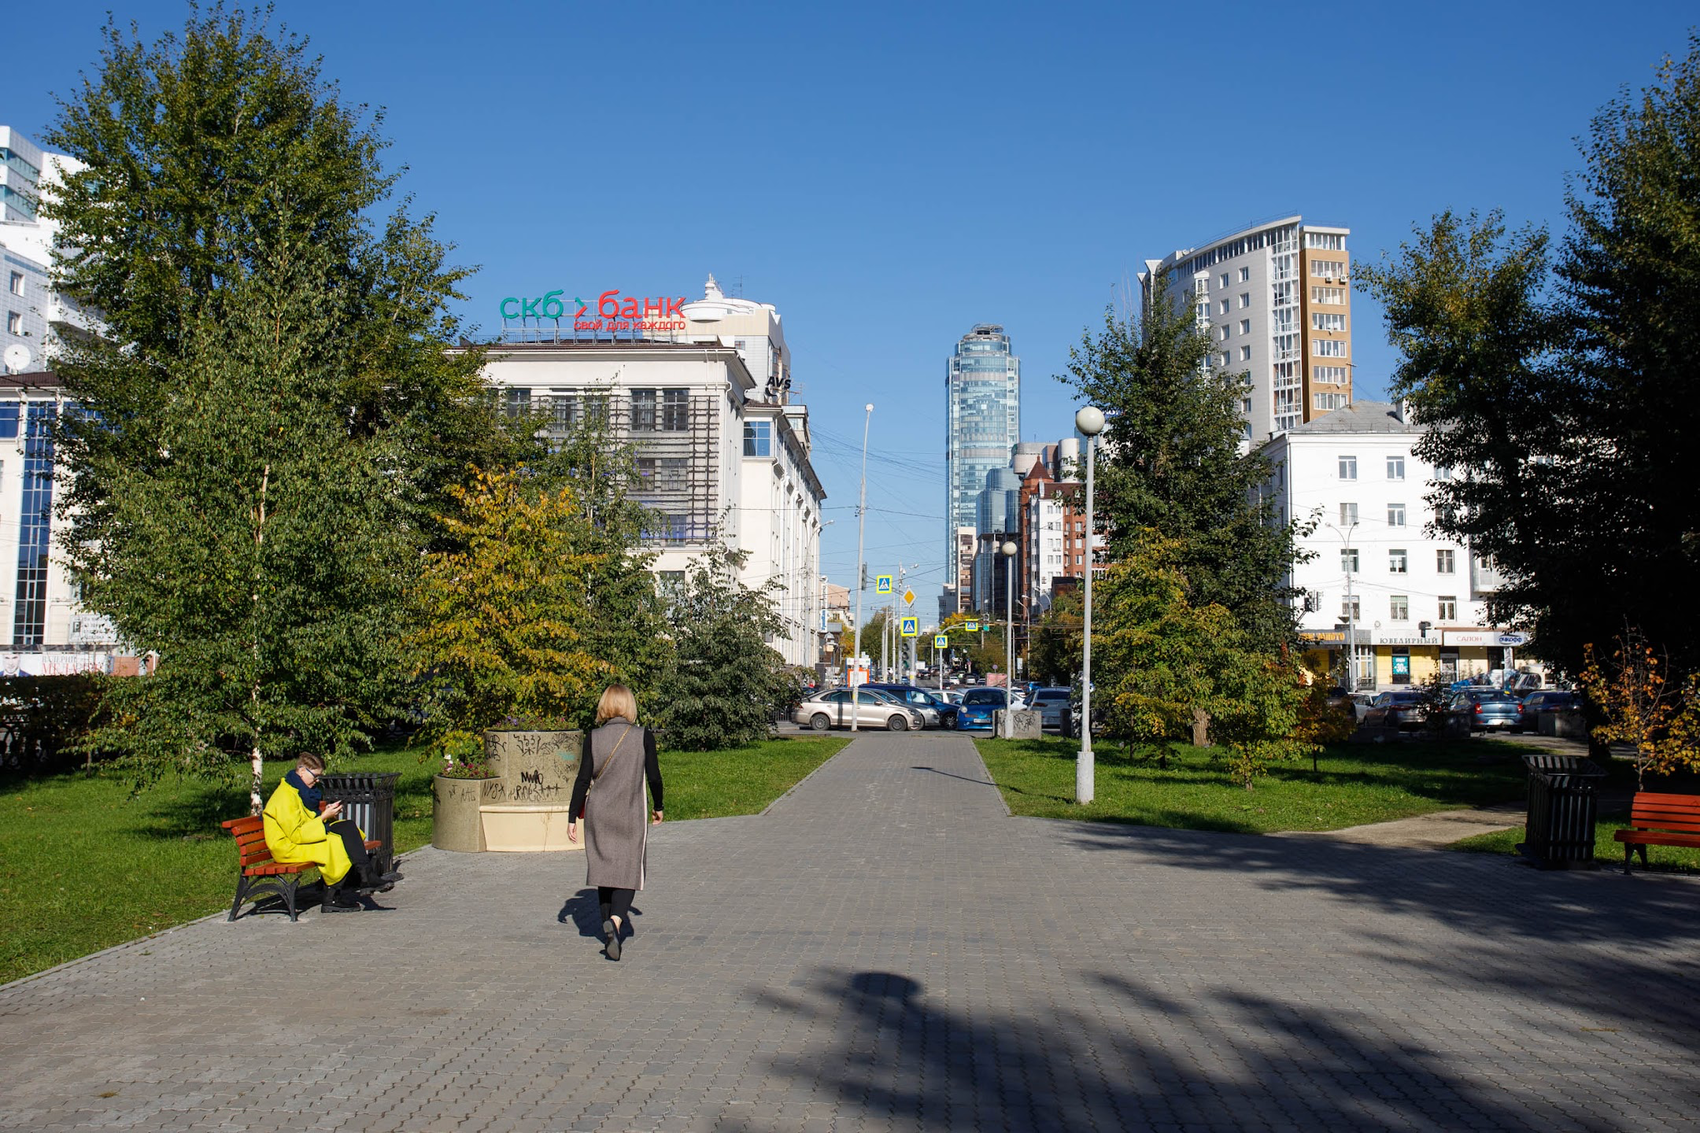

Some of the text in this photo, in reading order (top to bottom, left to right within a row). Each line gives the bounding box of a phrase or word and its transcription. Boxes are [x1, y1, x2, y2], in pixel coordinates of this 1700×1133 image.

[500, 289, 686, 319] скб банк
[574, 319, 686, 332] свой для каждого
